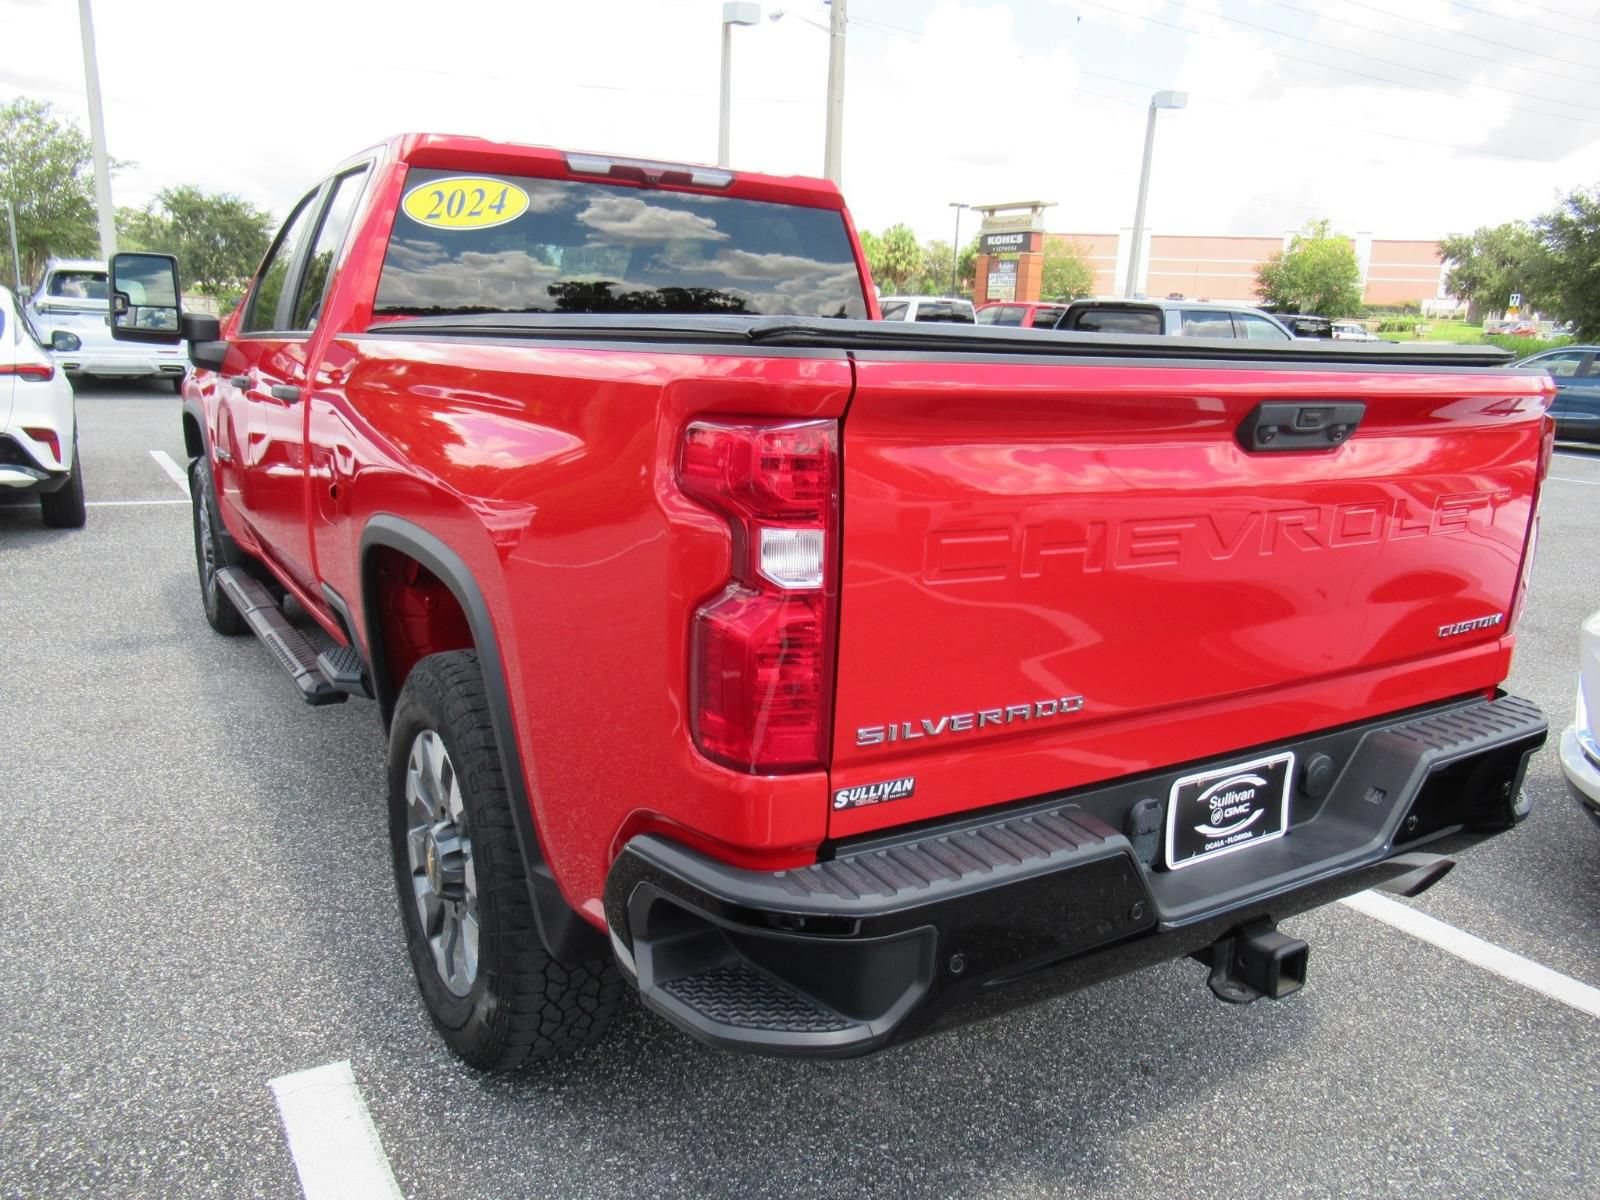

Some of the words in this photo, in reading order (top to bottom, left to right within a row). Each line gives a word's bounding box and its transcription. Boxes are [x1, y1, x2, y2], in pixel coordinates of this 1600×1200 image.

[424, 186, 509, 220] 2024
[987, 234, 1023, 245] KOHL'S
[922, 487, 1512, 586] CHEVROLET
[856, 695, 1084, 746] SILVERADO
[834, 778, 914, 808] SULLIVAN
[1209, 788, 1255, 809] Sullivan
[1224, 803, 1250, 818] GMC
[1205, 840, 1225, 850] OCALA
[1227, 832, 1253, 844] FLORIDA
